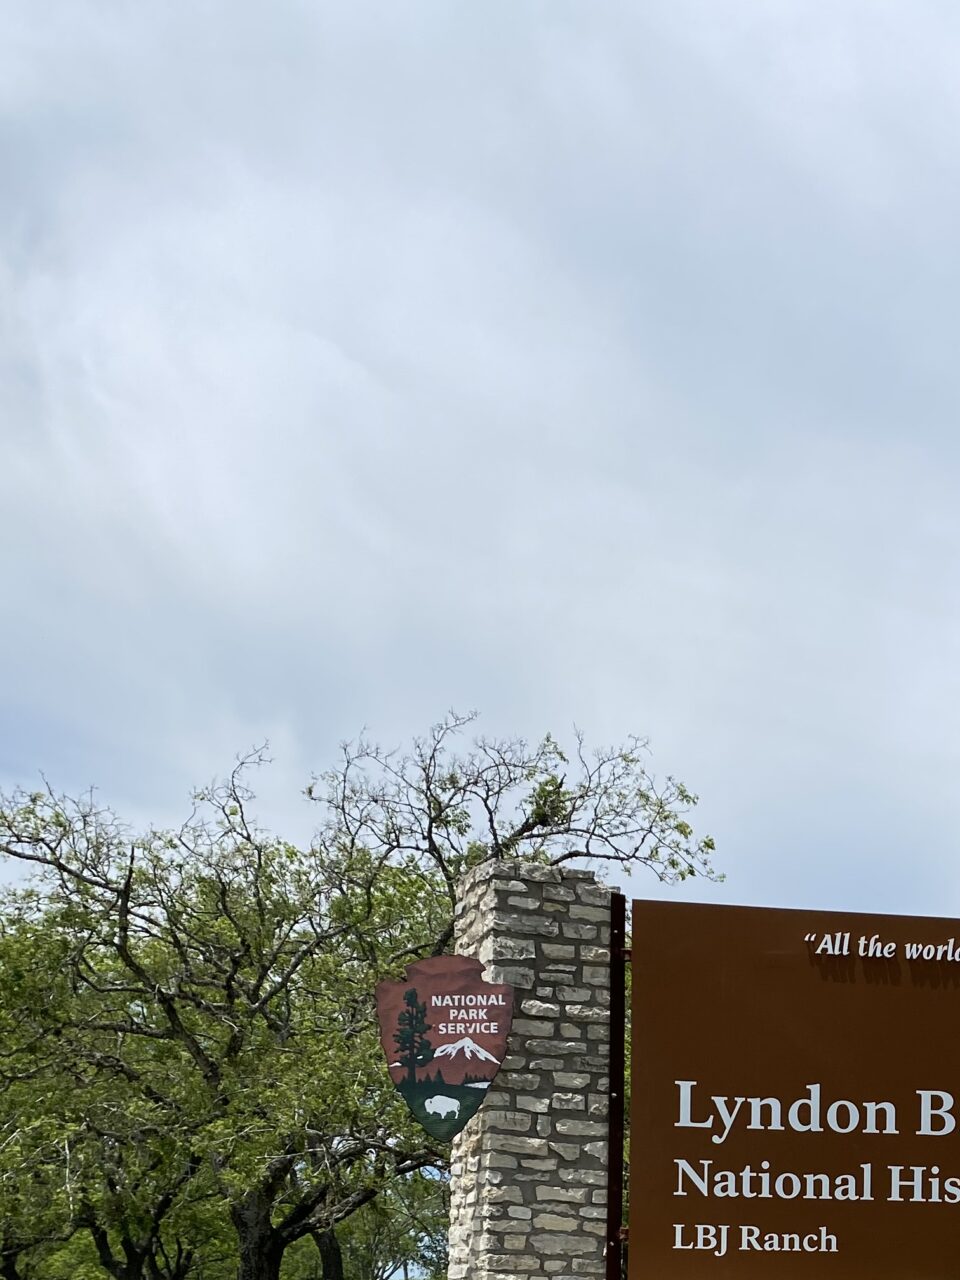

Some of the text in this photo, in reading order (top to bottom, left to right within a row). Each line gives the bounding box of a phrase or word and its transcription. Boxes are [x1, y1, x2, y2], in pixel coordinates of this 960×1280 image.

[857, 934, 897, 958] the
[431, 994, 506, 1007] NATIONAL
[449, 1008, 488, 1020] PARK
[438, 1022, 499, 1035] SERVICE
[674, 1080, 900, 1145] Lyndon
[673, 1158, 875, 1202] National
[672, 1224, 839, 1257] LBJ Ranch
